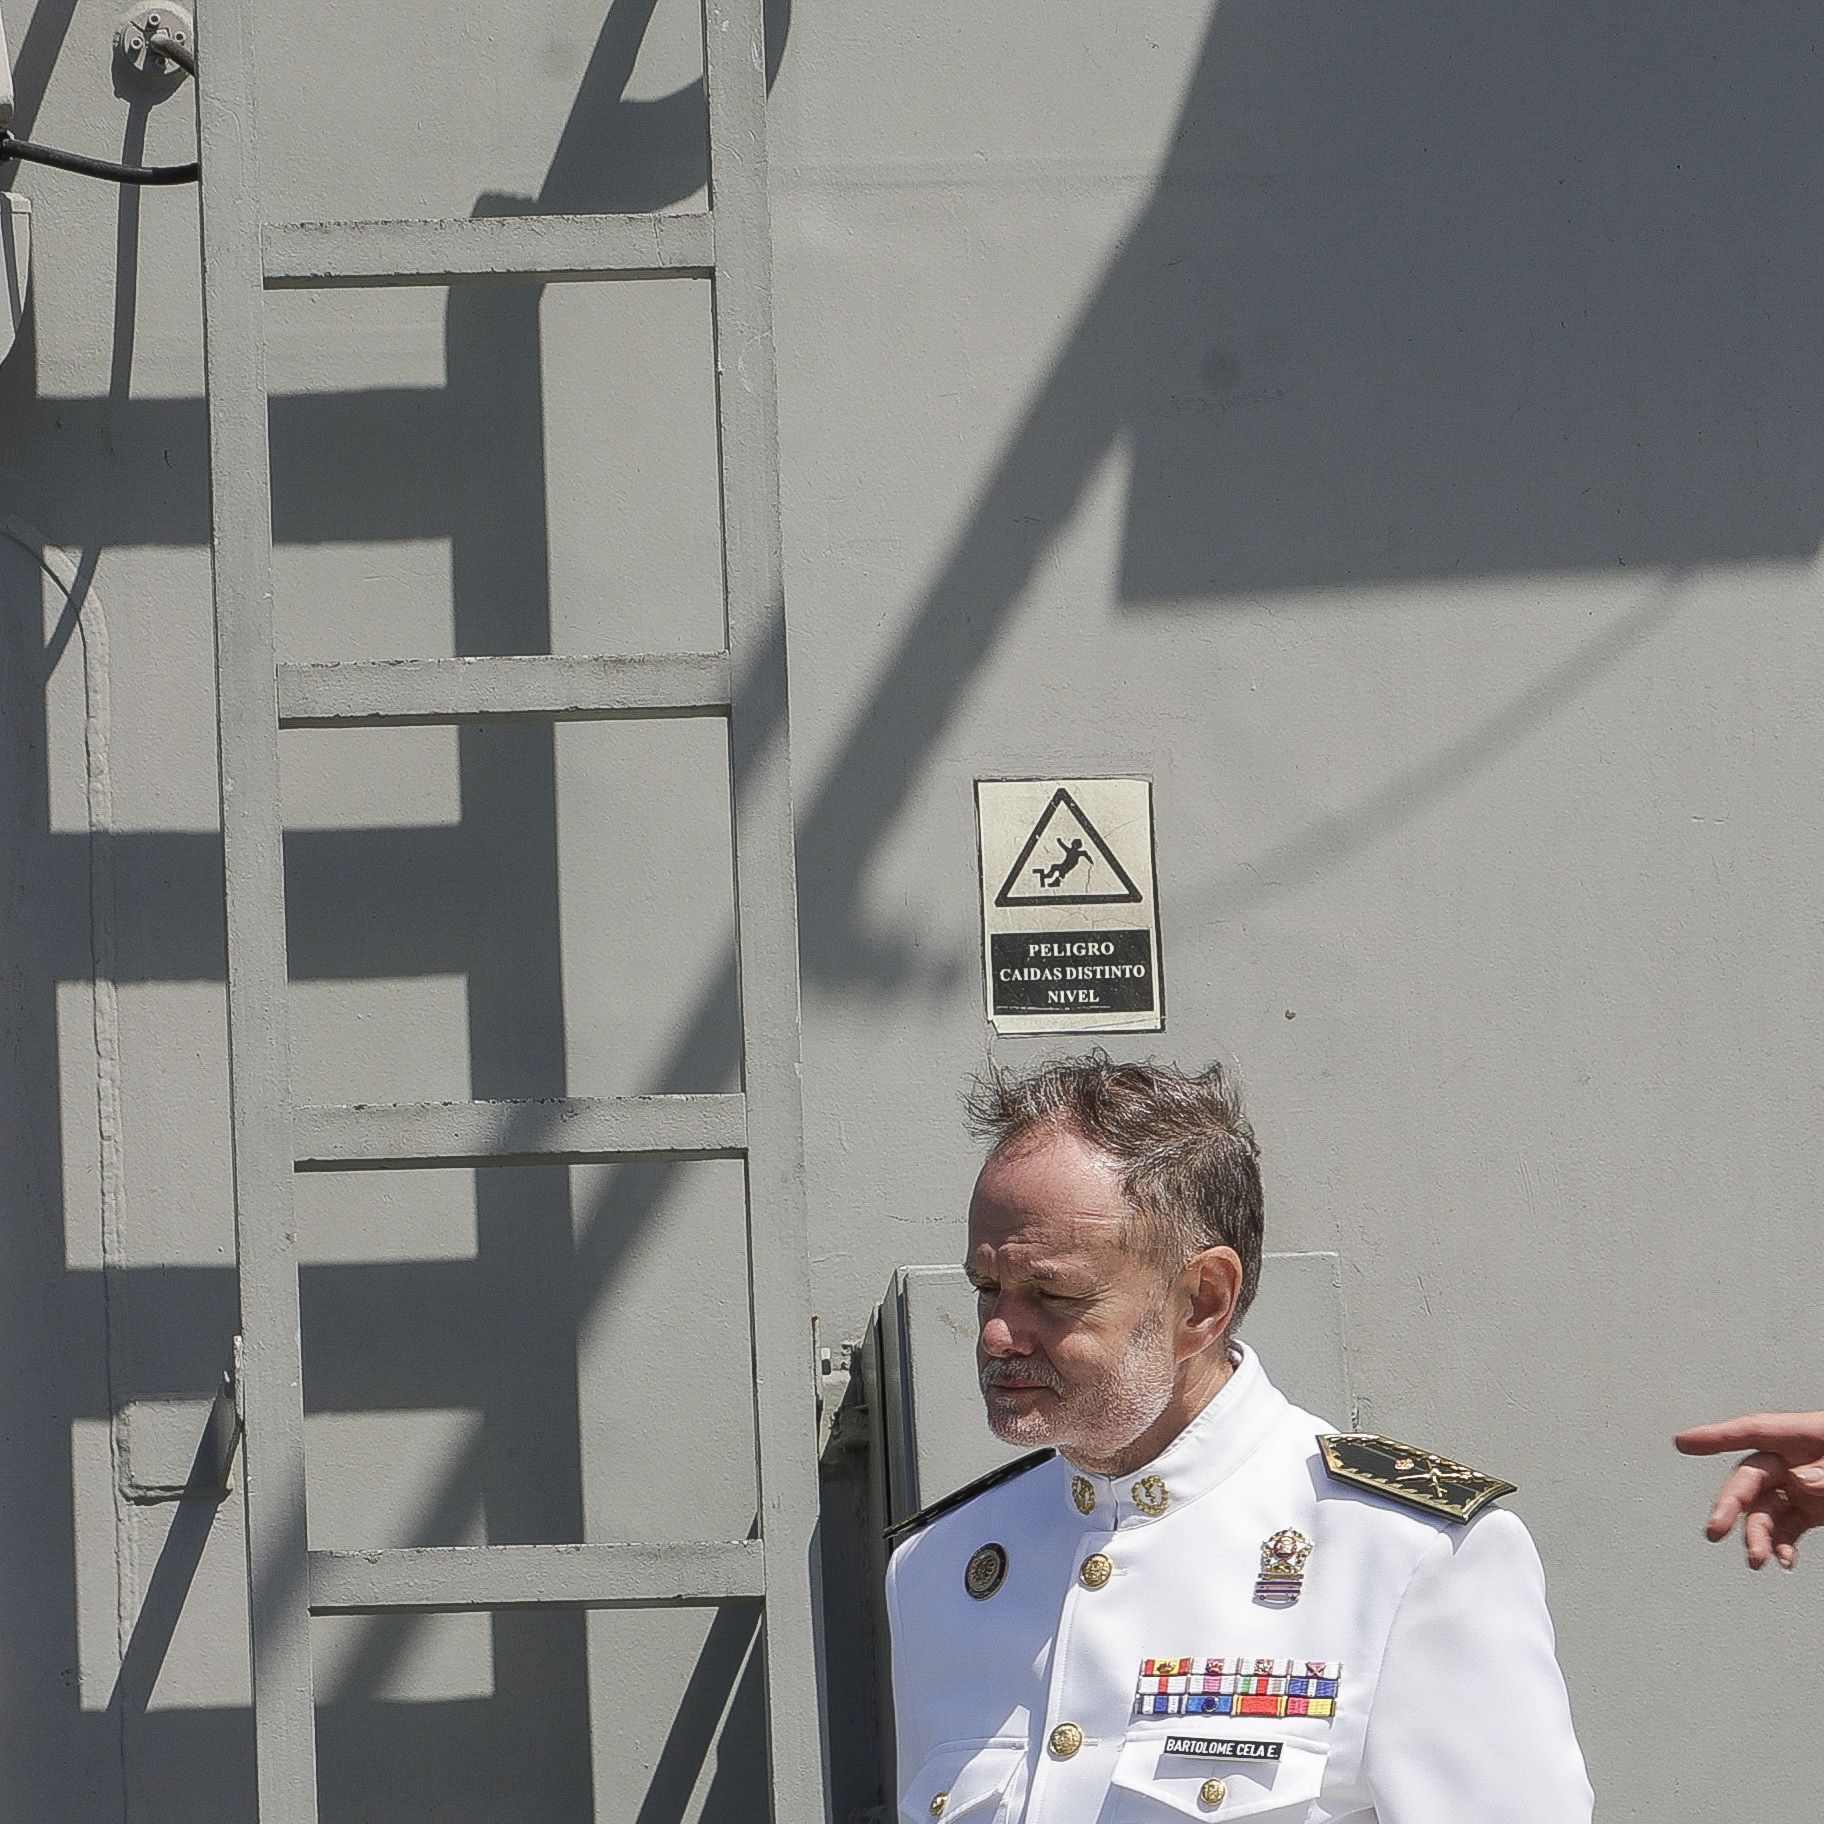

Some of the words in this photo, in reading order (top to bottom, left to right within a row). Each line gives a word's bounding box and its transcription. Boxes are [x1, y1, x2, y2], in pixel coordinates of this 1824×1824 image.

[1028, 941, 1115, 957] PELIGRO
[999, 966, 1062, 982] CAIDAS
[1065, 964, 1146, 980] DISTINTO
[1047, 989, 1100, 1004] NIVEL
[1166, 1738, 1235, 1755] BARTOLOME
[1236, 1743, 1265, 1757] CELA
[1266, 1744, 1280, 1758] E.
